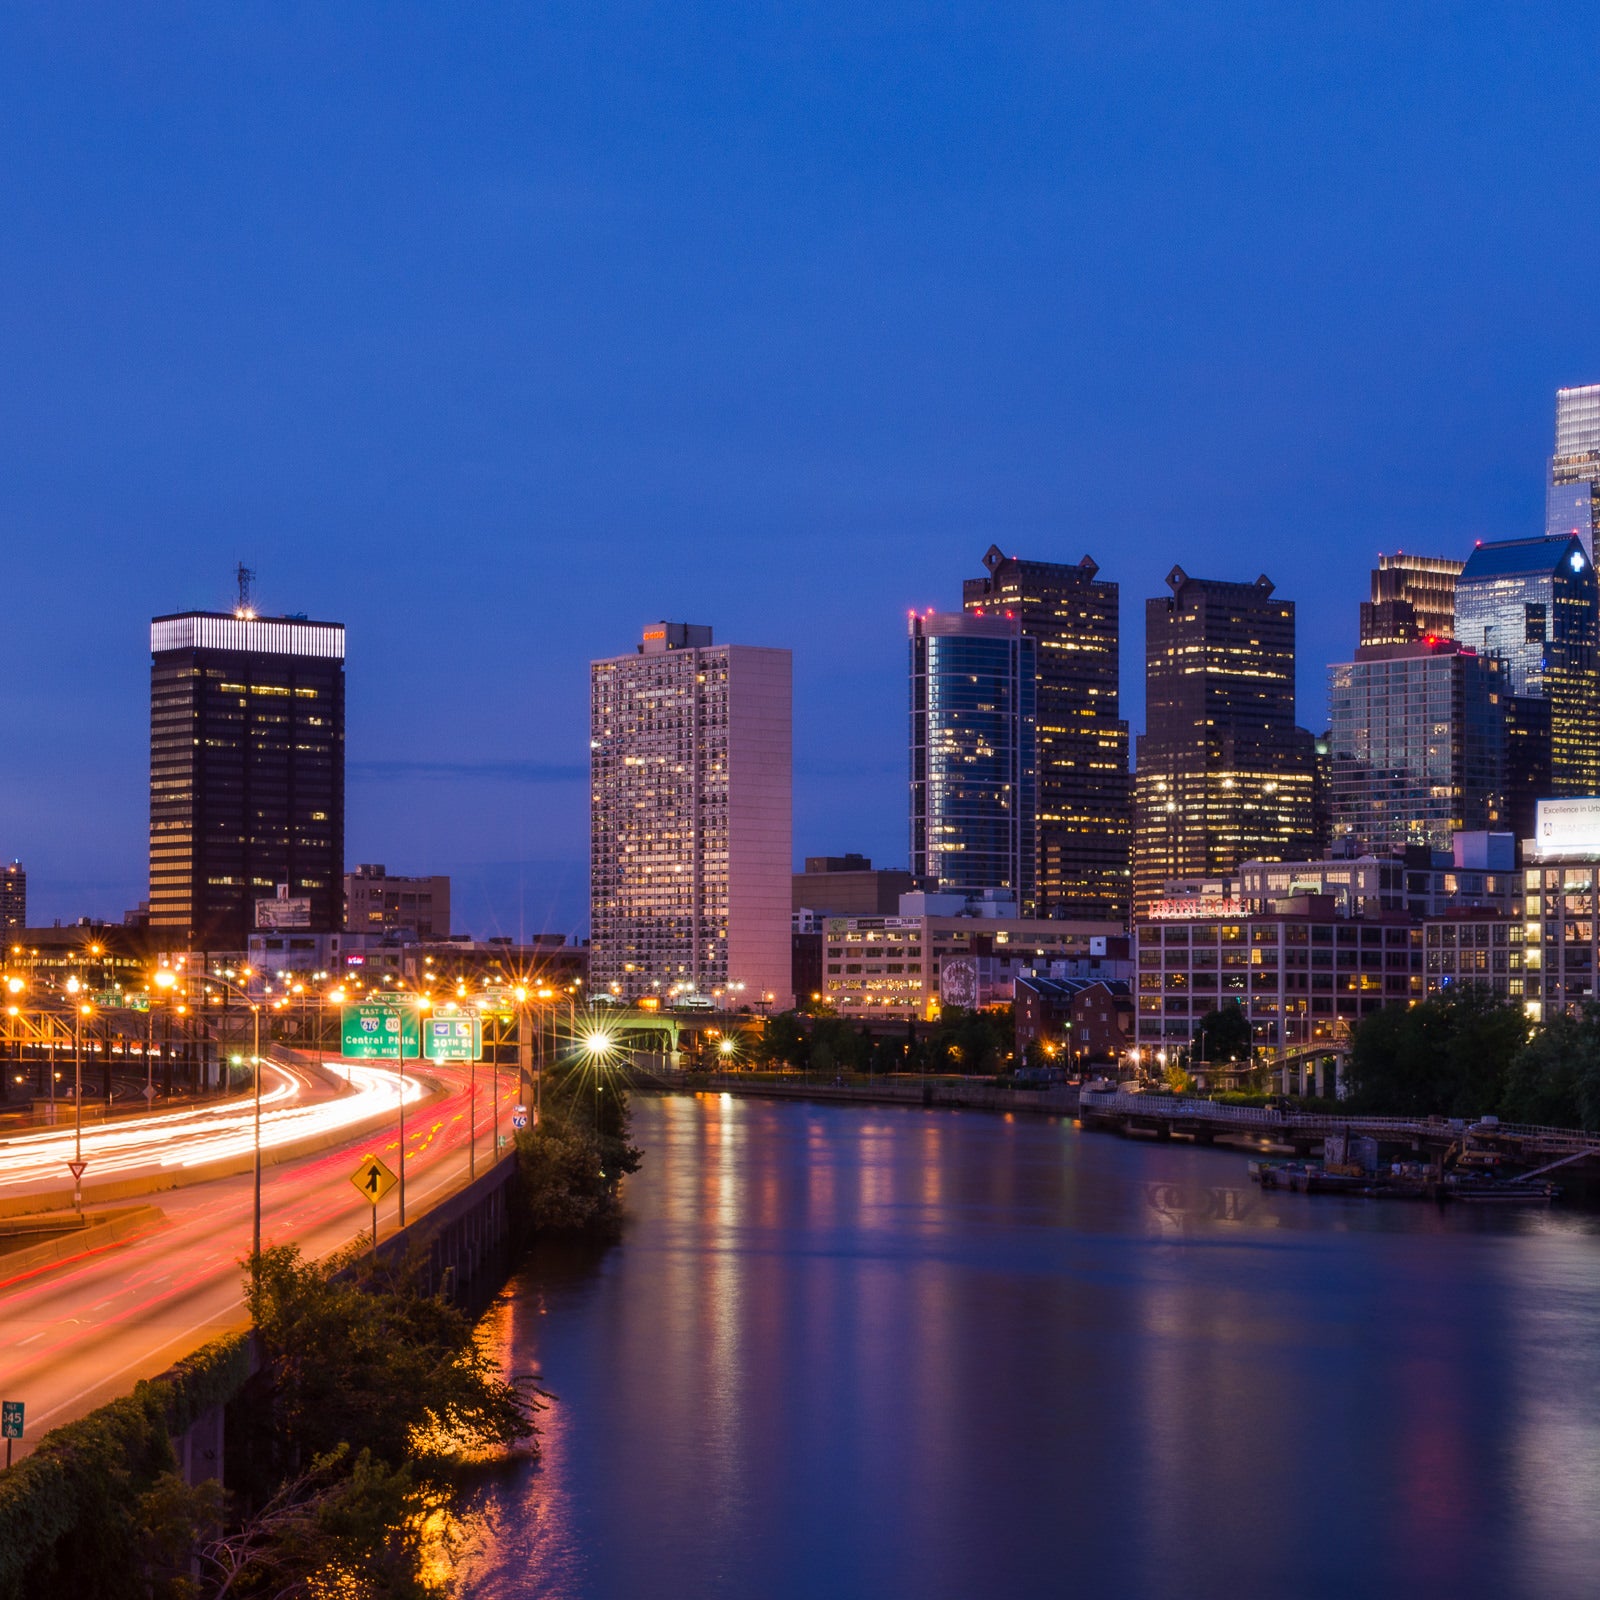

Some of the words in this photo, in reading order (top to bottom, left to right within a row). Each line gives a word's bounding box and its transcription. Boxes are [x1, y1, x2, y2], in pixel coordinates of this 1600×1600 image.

[1543, 805, 1578, 815] Excellence
[1579, 804, 1587, 812] in
[362, 1022, 379, 1030] 676
[386, 1020, 399, 1030] 30
[345, 1035, 383, 1044] Central
[433, 1038, 459, 1048] 30TH
[381, 1047, 398, 1055] MILE
[451, 1049, 467, 1057] MILE
[514, 1116, 526, 1126] 76
[3, 1412, 22, 1424] 345
